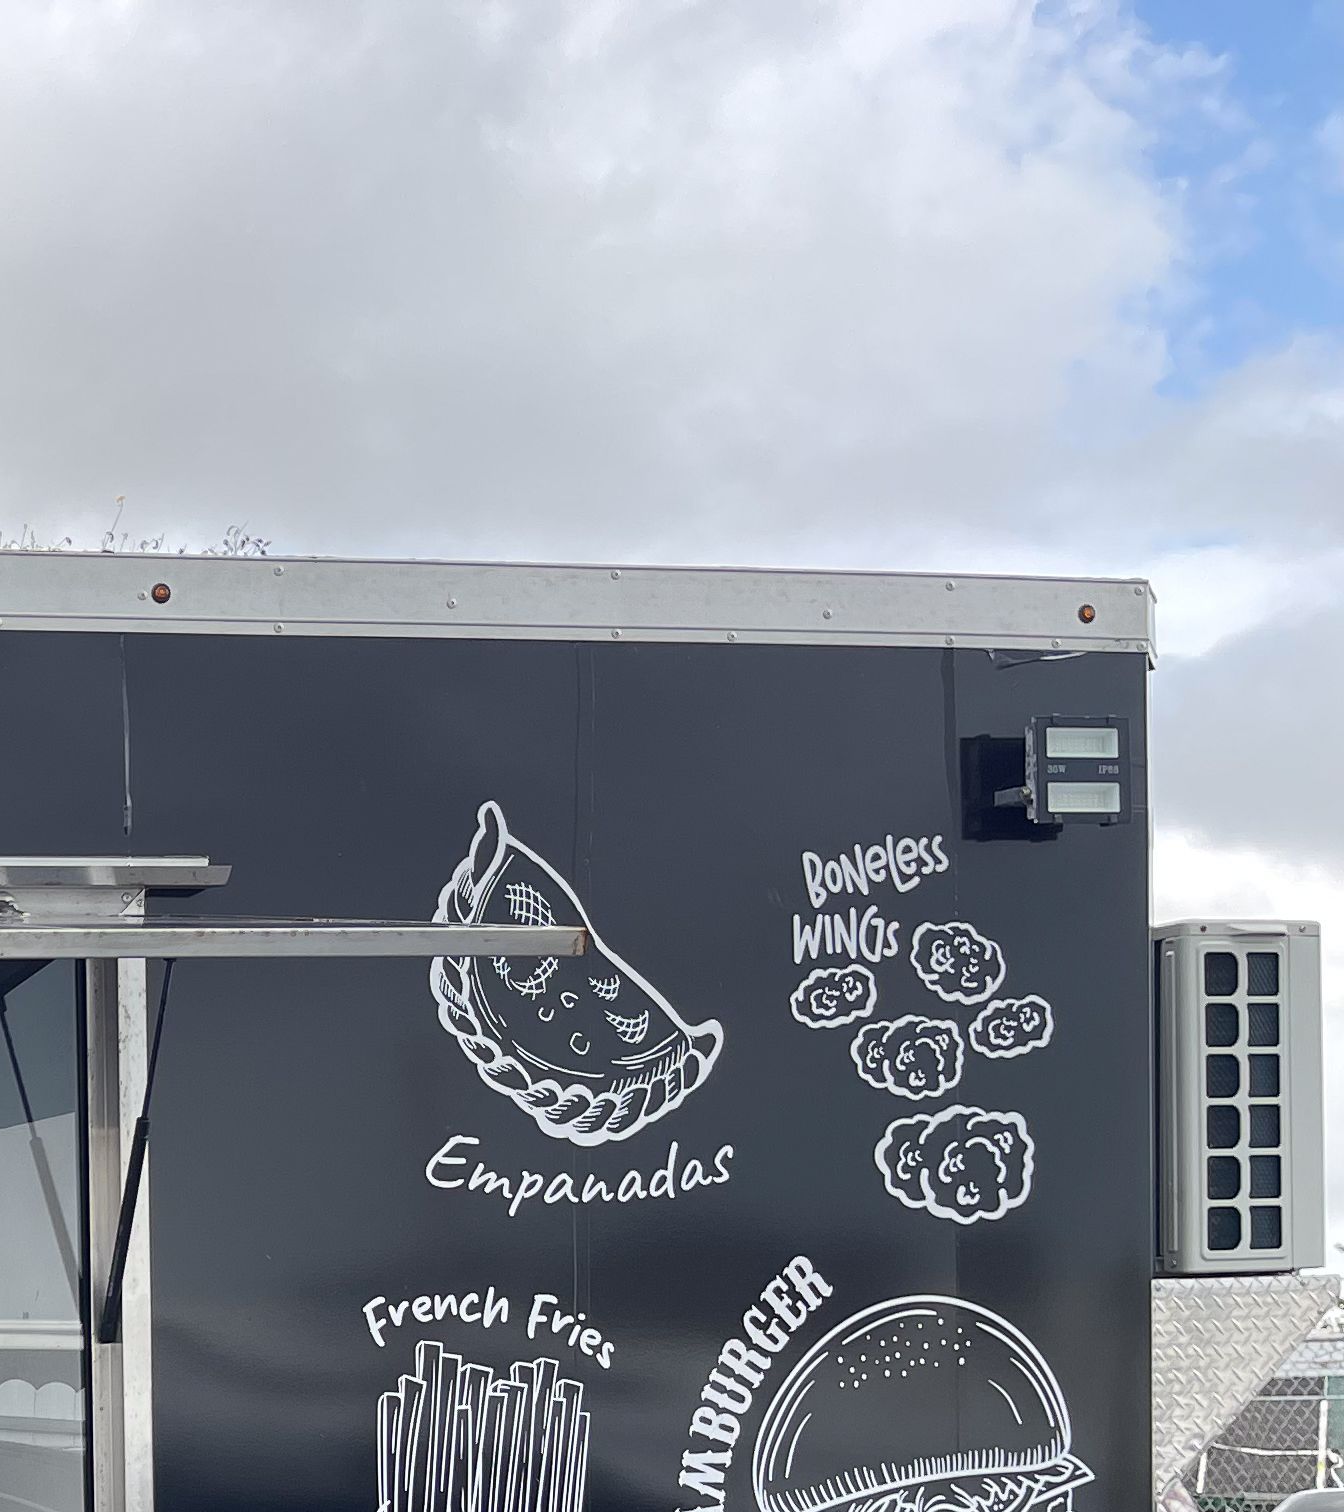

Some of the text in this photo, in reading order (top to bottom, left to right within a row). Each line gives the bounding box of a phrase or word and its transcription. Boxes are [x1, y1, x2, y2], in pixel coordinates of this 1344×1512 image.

[425, 1134, 734, 1217] Empanadas
[362, 1286, 615, 1369] French Fries
